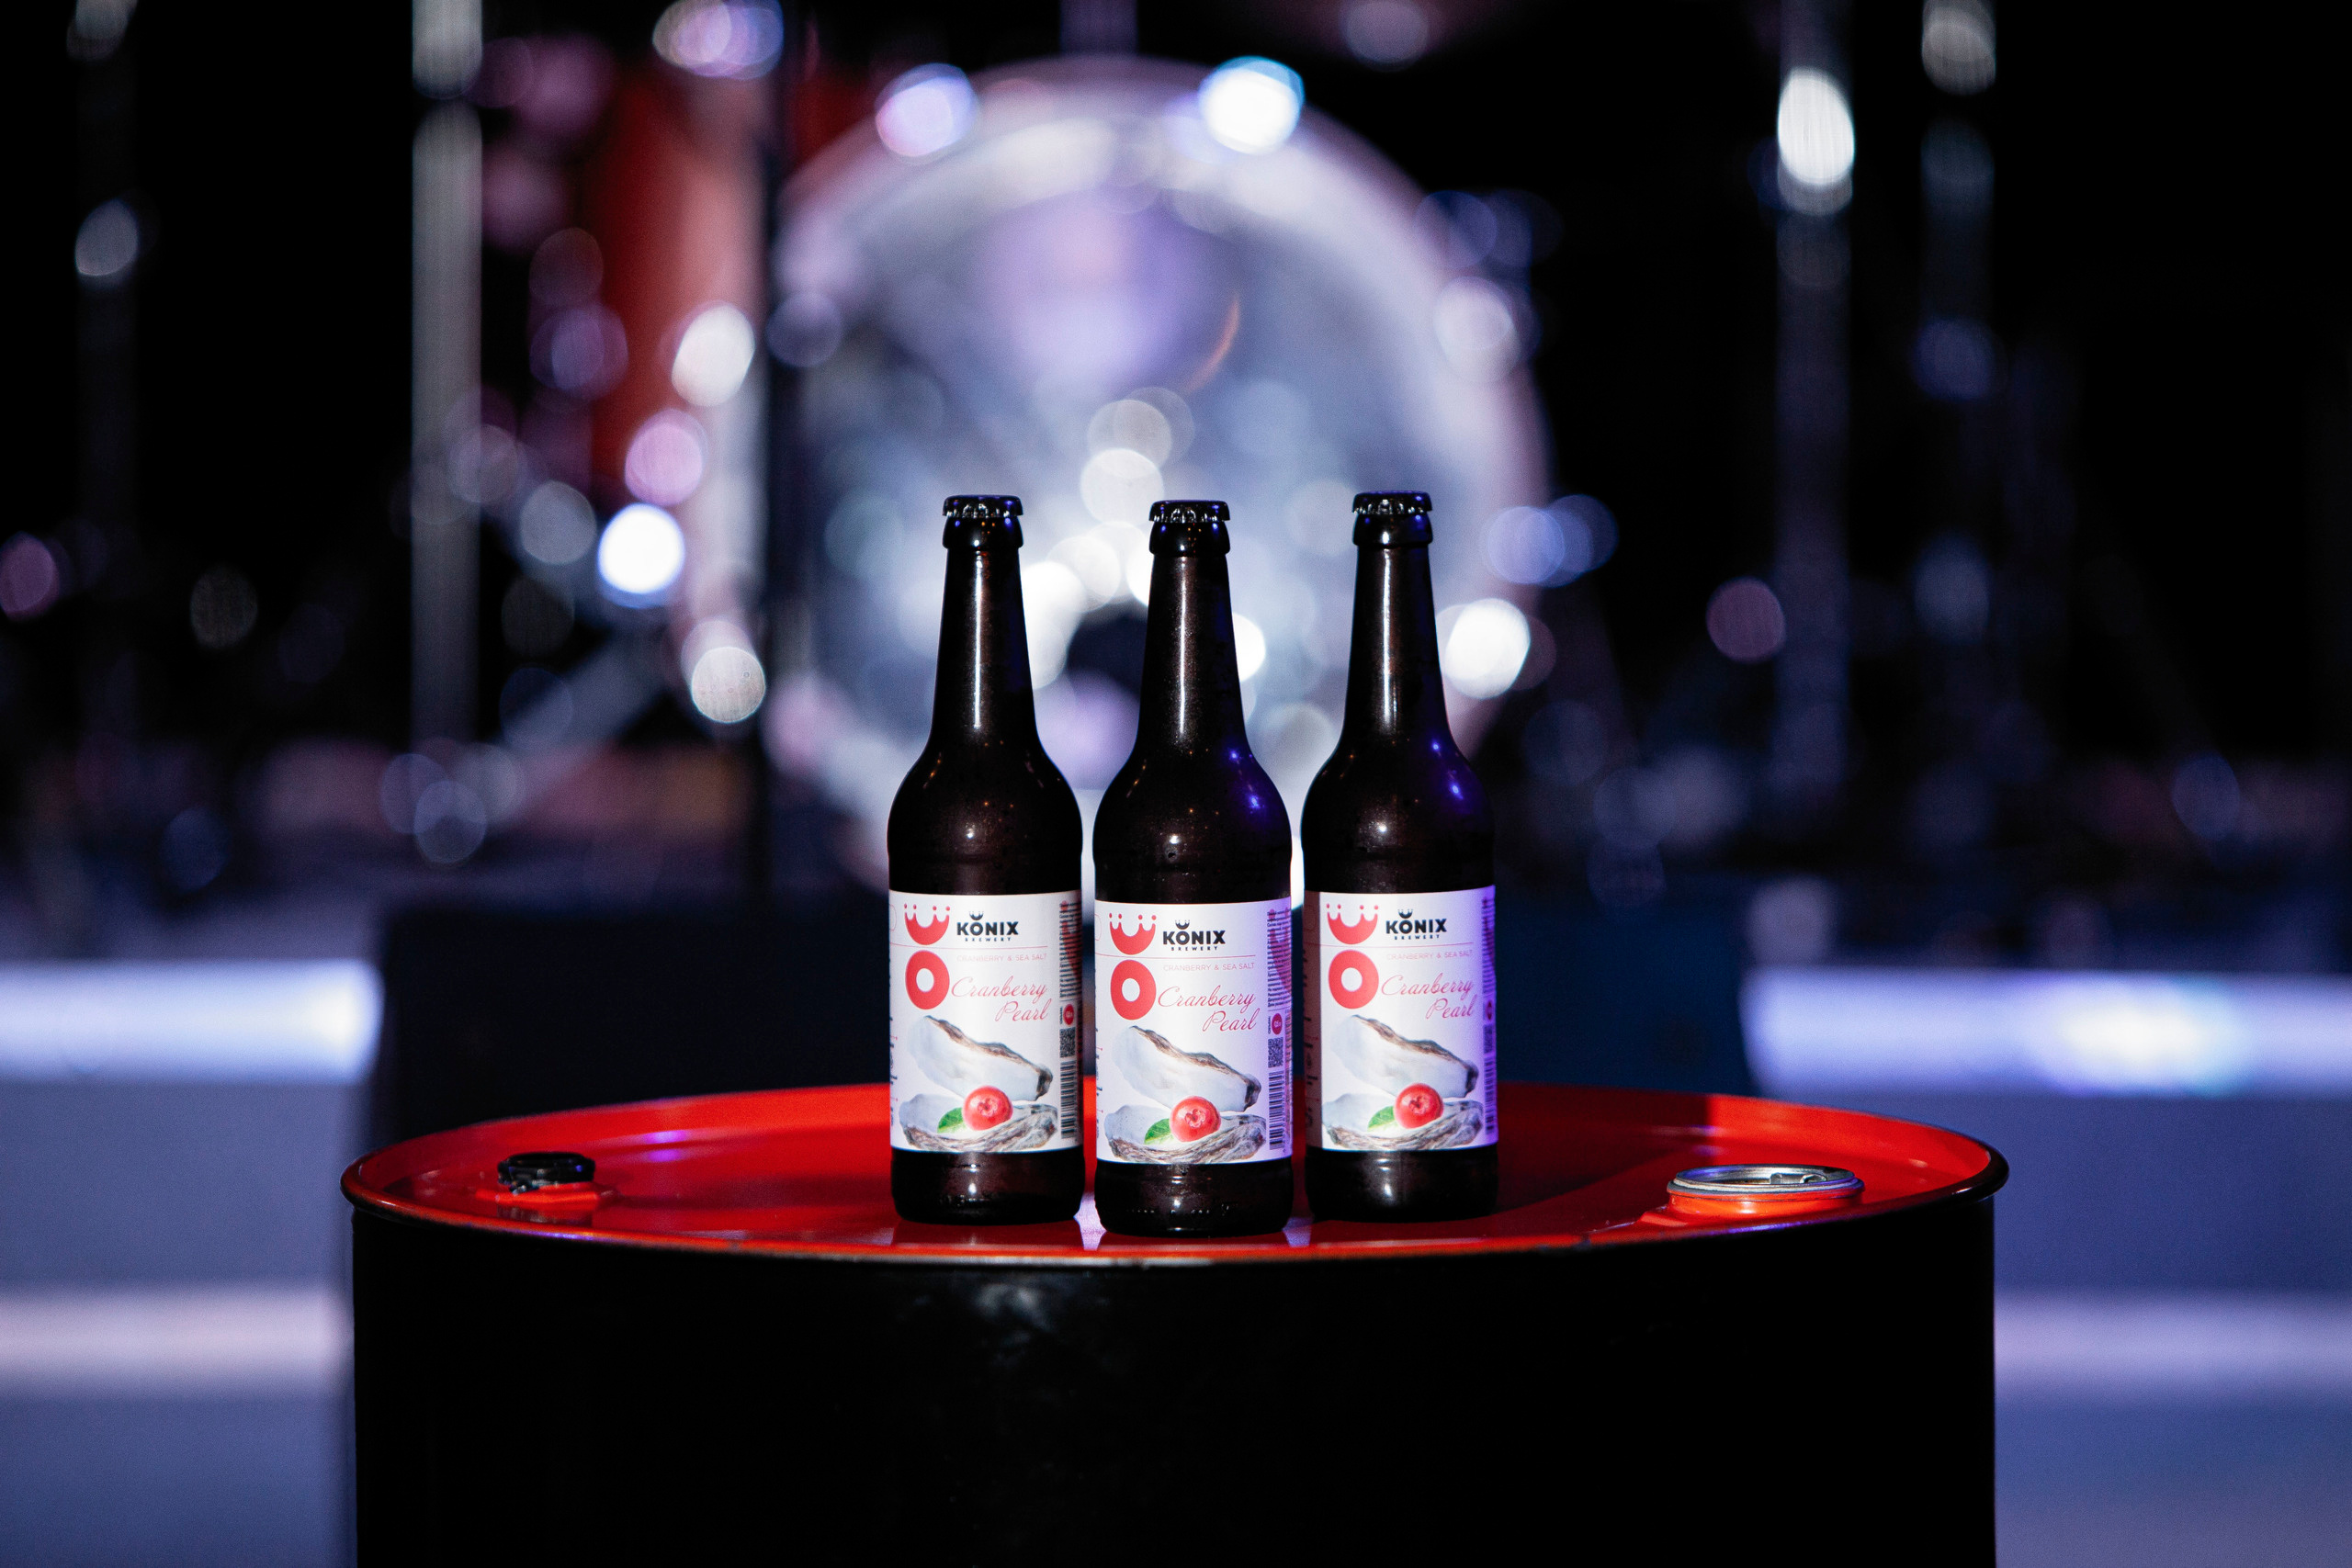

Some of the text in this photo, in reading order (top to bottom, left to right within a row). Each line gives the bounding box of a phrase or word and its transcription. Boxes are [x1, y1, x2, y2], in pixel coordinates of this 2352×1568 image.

[956, 954, 1004, 963] CRANBERRY
[1015, 953, 1029, 962] SEA
[1031, 953, 1048, 961] SALT
[1222, 963, 1238, 971] SEA
[1238, 962, 1255, 970] SALT
[1387, 953, 1434, 961] CRANBERRY
[1444, 951, 1458, 959] SEA
[951, 976, 1047, 1004] Cranberry
[1381, 972, 1473, 1001] Cranberry
[994, 998, 1052, 1021] Pearl
[1158, 985, 1256, 1013] Cranberry
[1425, 994, 1477, 1019] Pearl
[1202, 1008, 1261, 1032] Pearl
